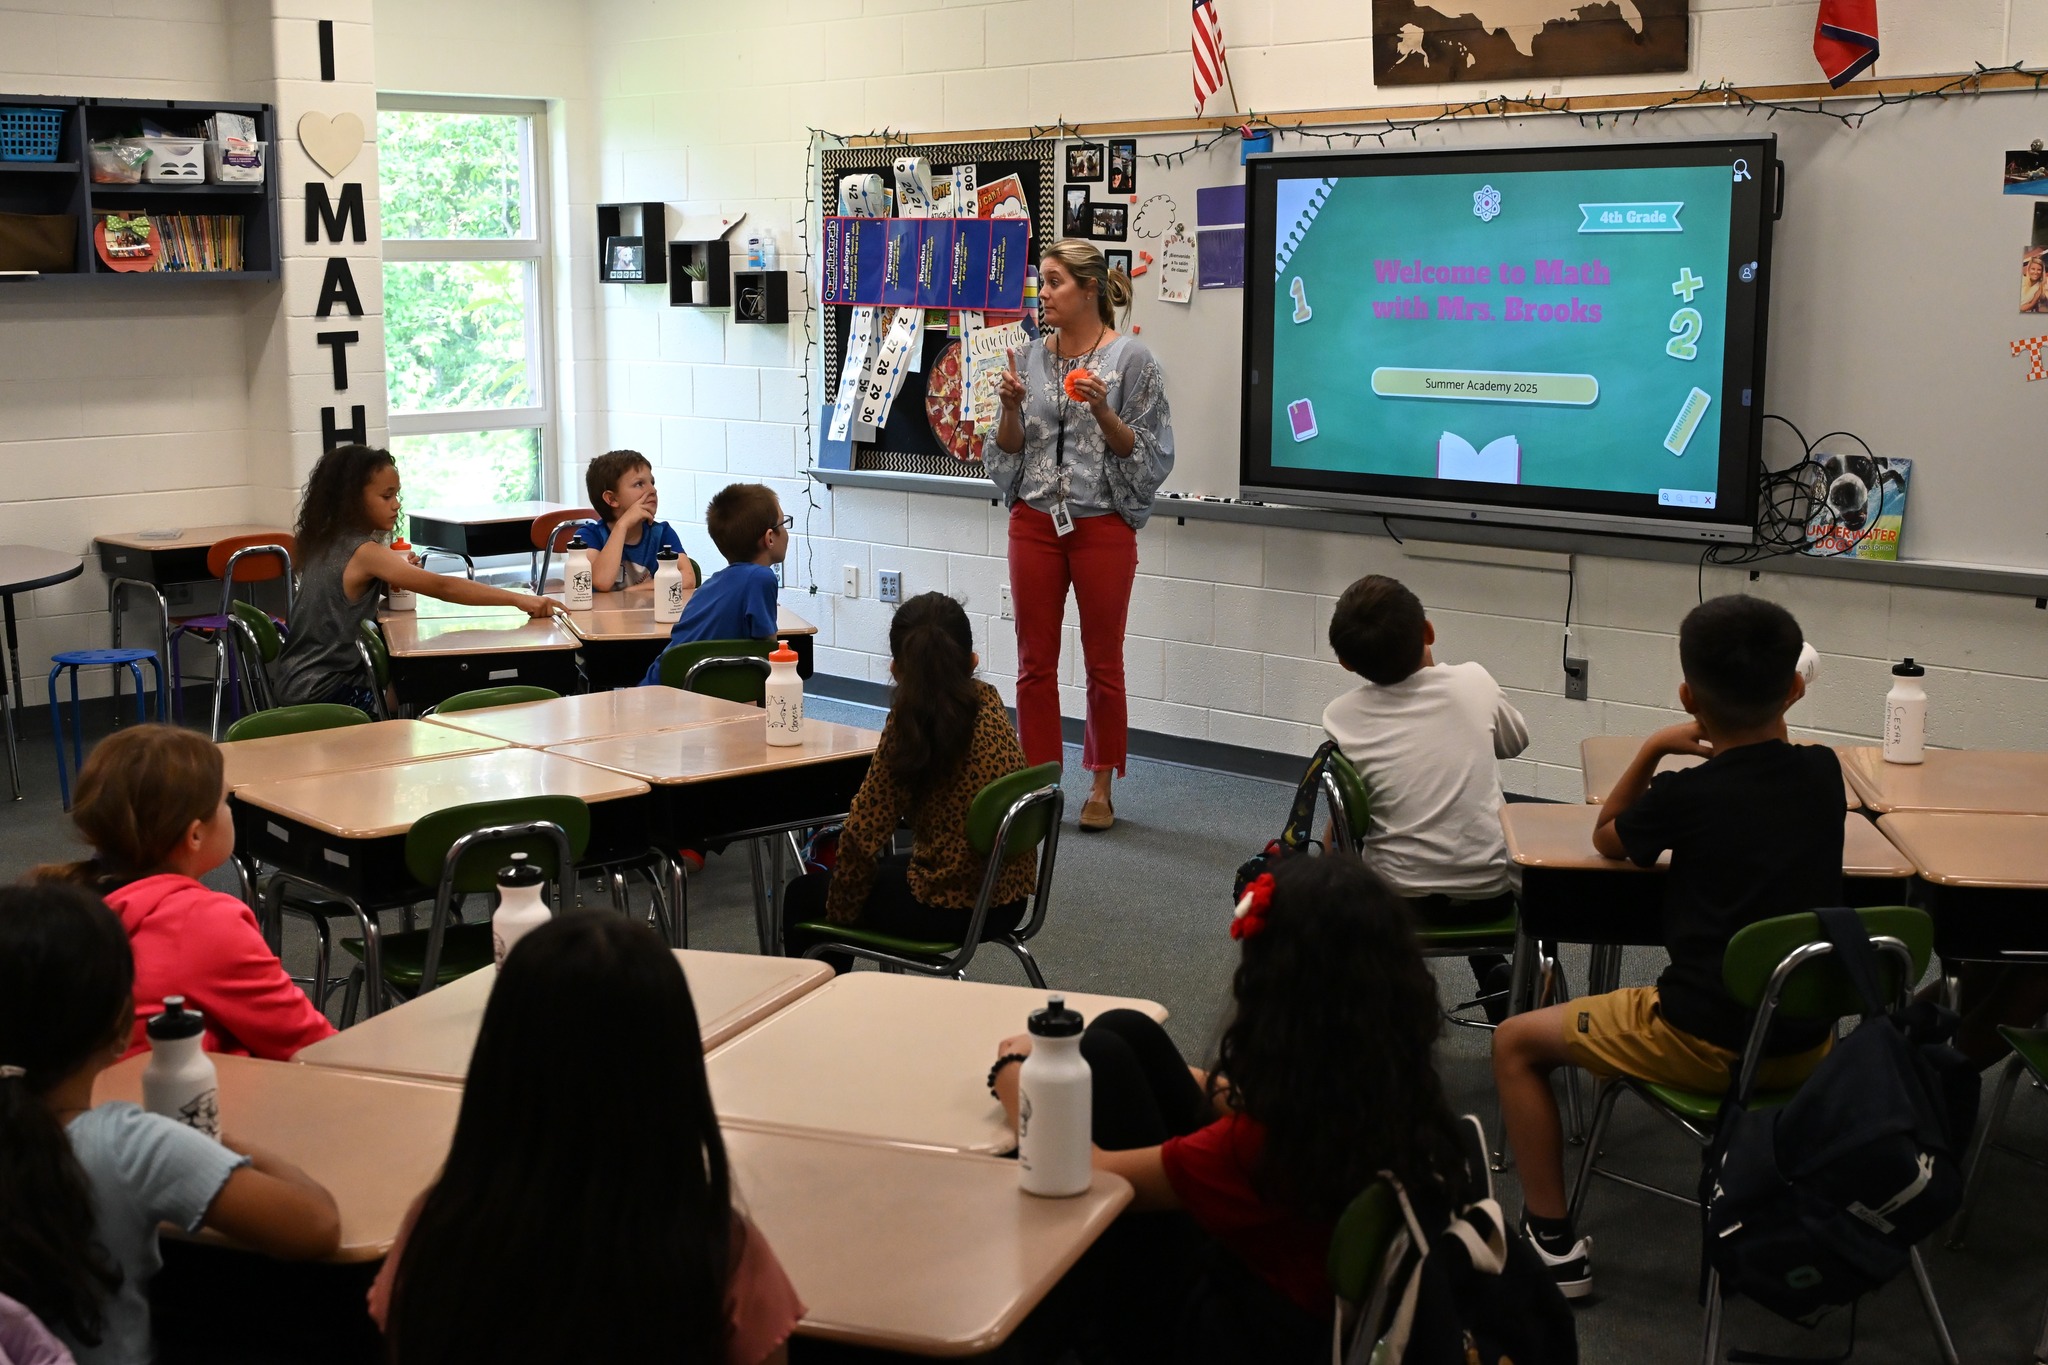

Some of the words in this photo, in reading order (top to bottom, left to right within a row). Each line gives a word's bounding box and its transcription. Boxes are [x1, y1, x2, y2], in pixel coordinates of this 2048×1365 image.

[318, 20, 335, 81] I
[848, 184, 859, 200] 42
[901, 181, 915, 194] 20
[911, 197, 922, 208] 21
[983, 187, 1003, 205] CAN'T
[967, 200, 976, 216] 79
[1599, 210, 1624, 224] 4th
[1626, 209, 1667, 225] Grade
[825, 220, 836, 300] Quadrilaterals
[885, 241, 893, 283] Trapezoid
[952, 242, 960, 285] Rectangle
[989, 248, 997, 281] Square
[1373, 259, 1491, 285] Welcome
[1499, 261, 1526, 285] to
[1534, 259, 1611, 286] Math
[305, 182, 367, 455] MATH
[1372, 297, 1429, 321] with
[1437, 297, 1497, 322] Mrs.
[1504, 297, 1602, 323] Brooks
[886, 339, 898, 354] 27
[877, 359, 889, 376] 28
[869, 383, 882, 400] 29
[1425, 377, 1464, 391] Summer
[1466, 378, 1511, 395] Academy
[1513, 382, 1538, 394] 2025
[862, 406, 875, 423] 30
[1806, 523, 1897, 543] UNDERWATER
[1815, 536, 1854, 553] DOGS
[1891, 706, 1906, 745] CESAR
